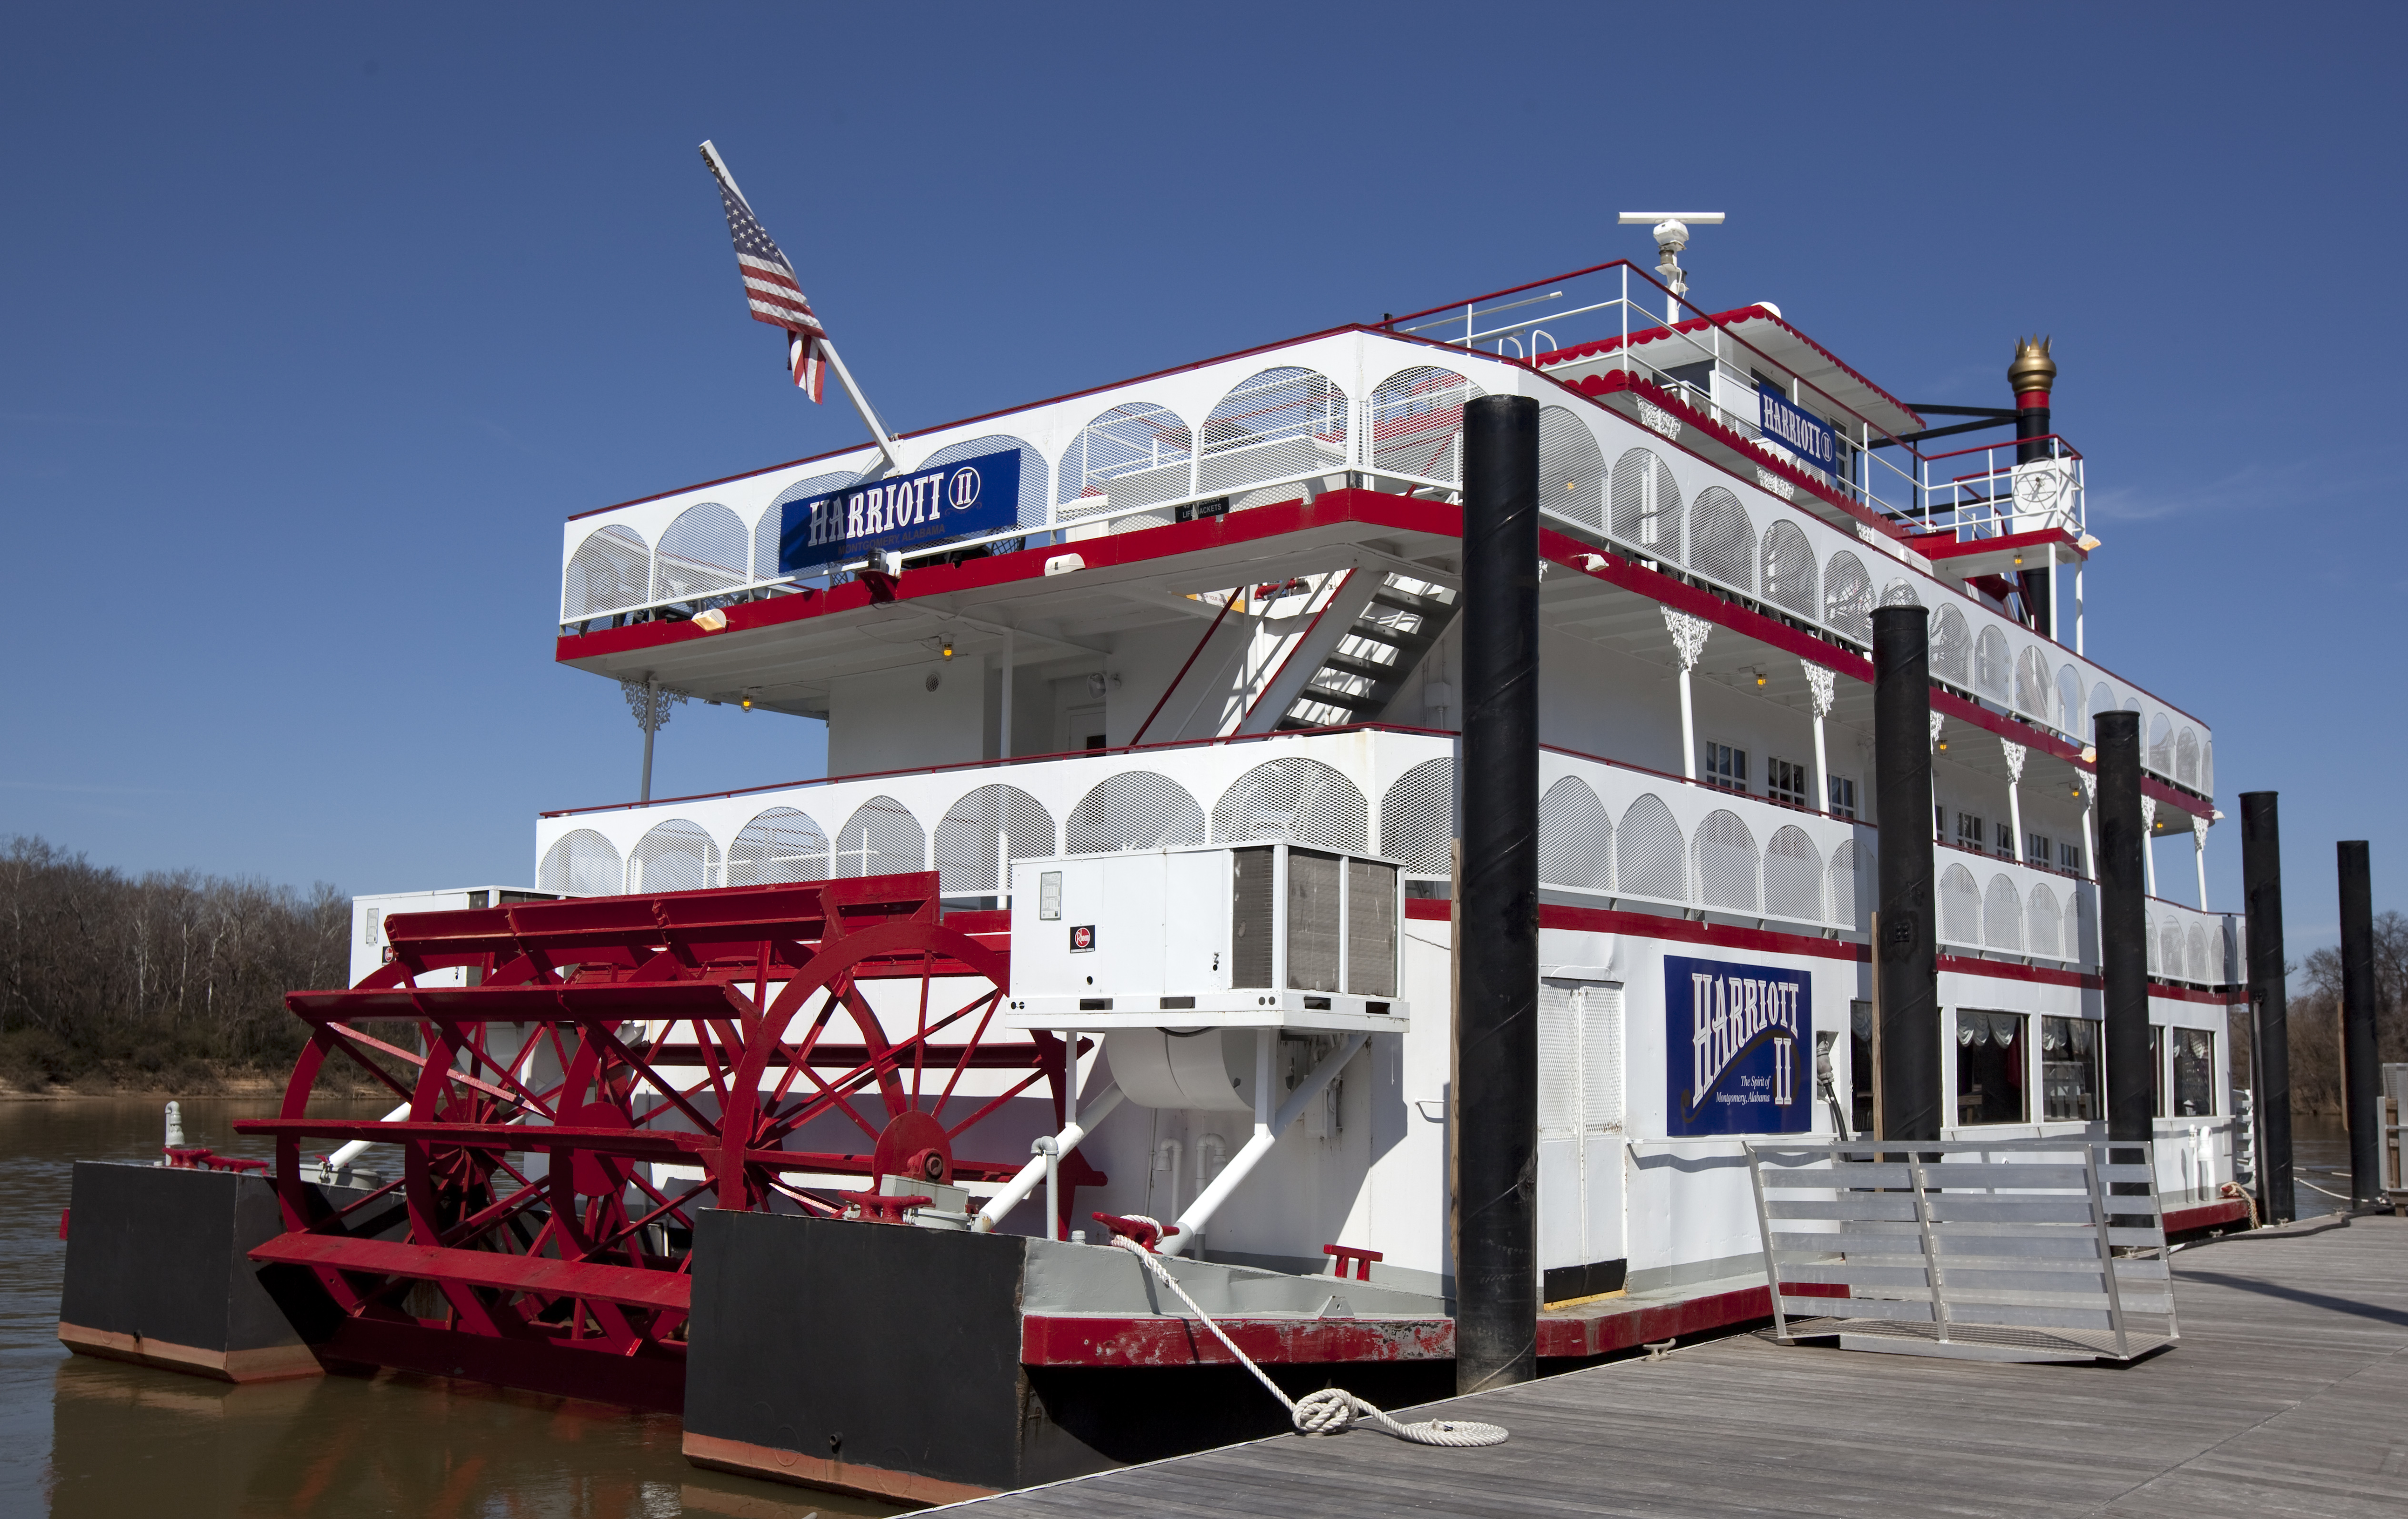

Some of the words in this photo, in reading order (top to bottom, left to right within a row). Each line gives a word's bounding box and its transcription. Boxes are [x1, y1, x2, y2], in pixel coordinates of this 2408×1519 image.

[1763, 394, 1820, 459] HARRIOTT
[808, 472, 944, 547] HARRIOTT
[956, 471, 973, 505] II
[1199, 503, 1221, 514] ACKETS
[838, 533, 900, 555] MONTGOMERY,
[902, 524, 945, 542] ALABAMA
[1692, 973, 1799, 1109] HARRIOTT
[1741, 1076, 1750, 1086] The
[1751, 1076, 1764, 1089] Spirit
[1765, 1076, 1771, 1090] of
[1774, 1037, 1792, 1105] II
[1716, 1092, 1747, 1106] Montgomery,
[1748, 1091, 1770, 1102] Alabama
